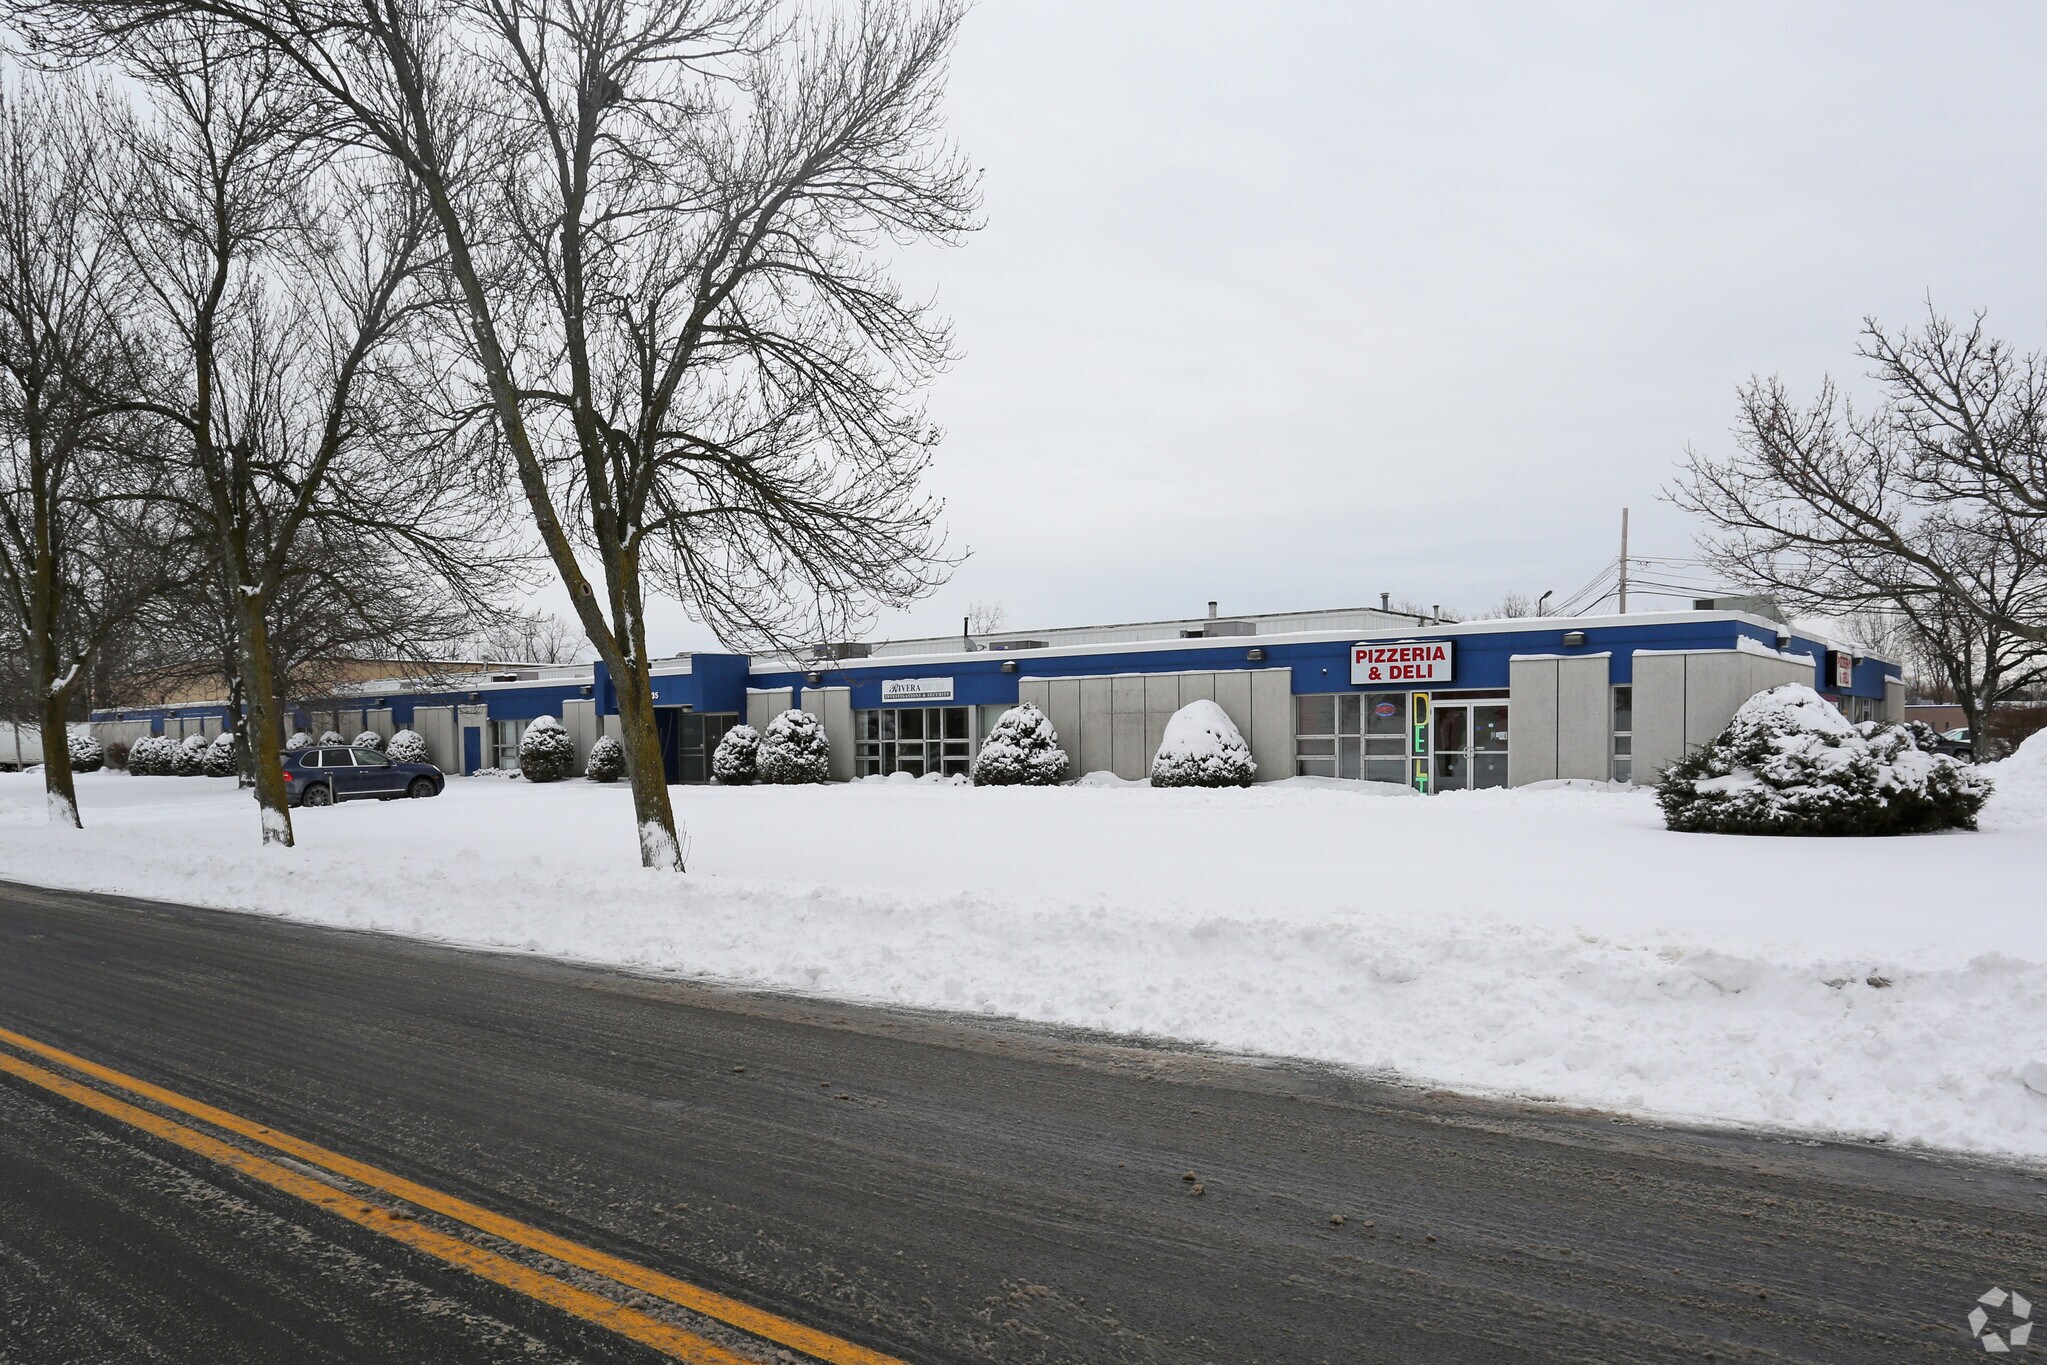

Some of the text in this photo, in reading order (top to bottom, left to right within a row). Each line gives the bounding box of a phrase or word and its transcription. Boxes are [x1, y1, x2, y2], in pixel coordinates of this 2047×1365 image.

[1355, 646, 1446, 664] PIZZERIA
[1368, 664, 1433, 681] & DELI
[889, 683, 921, 693] RIVERA
